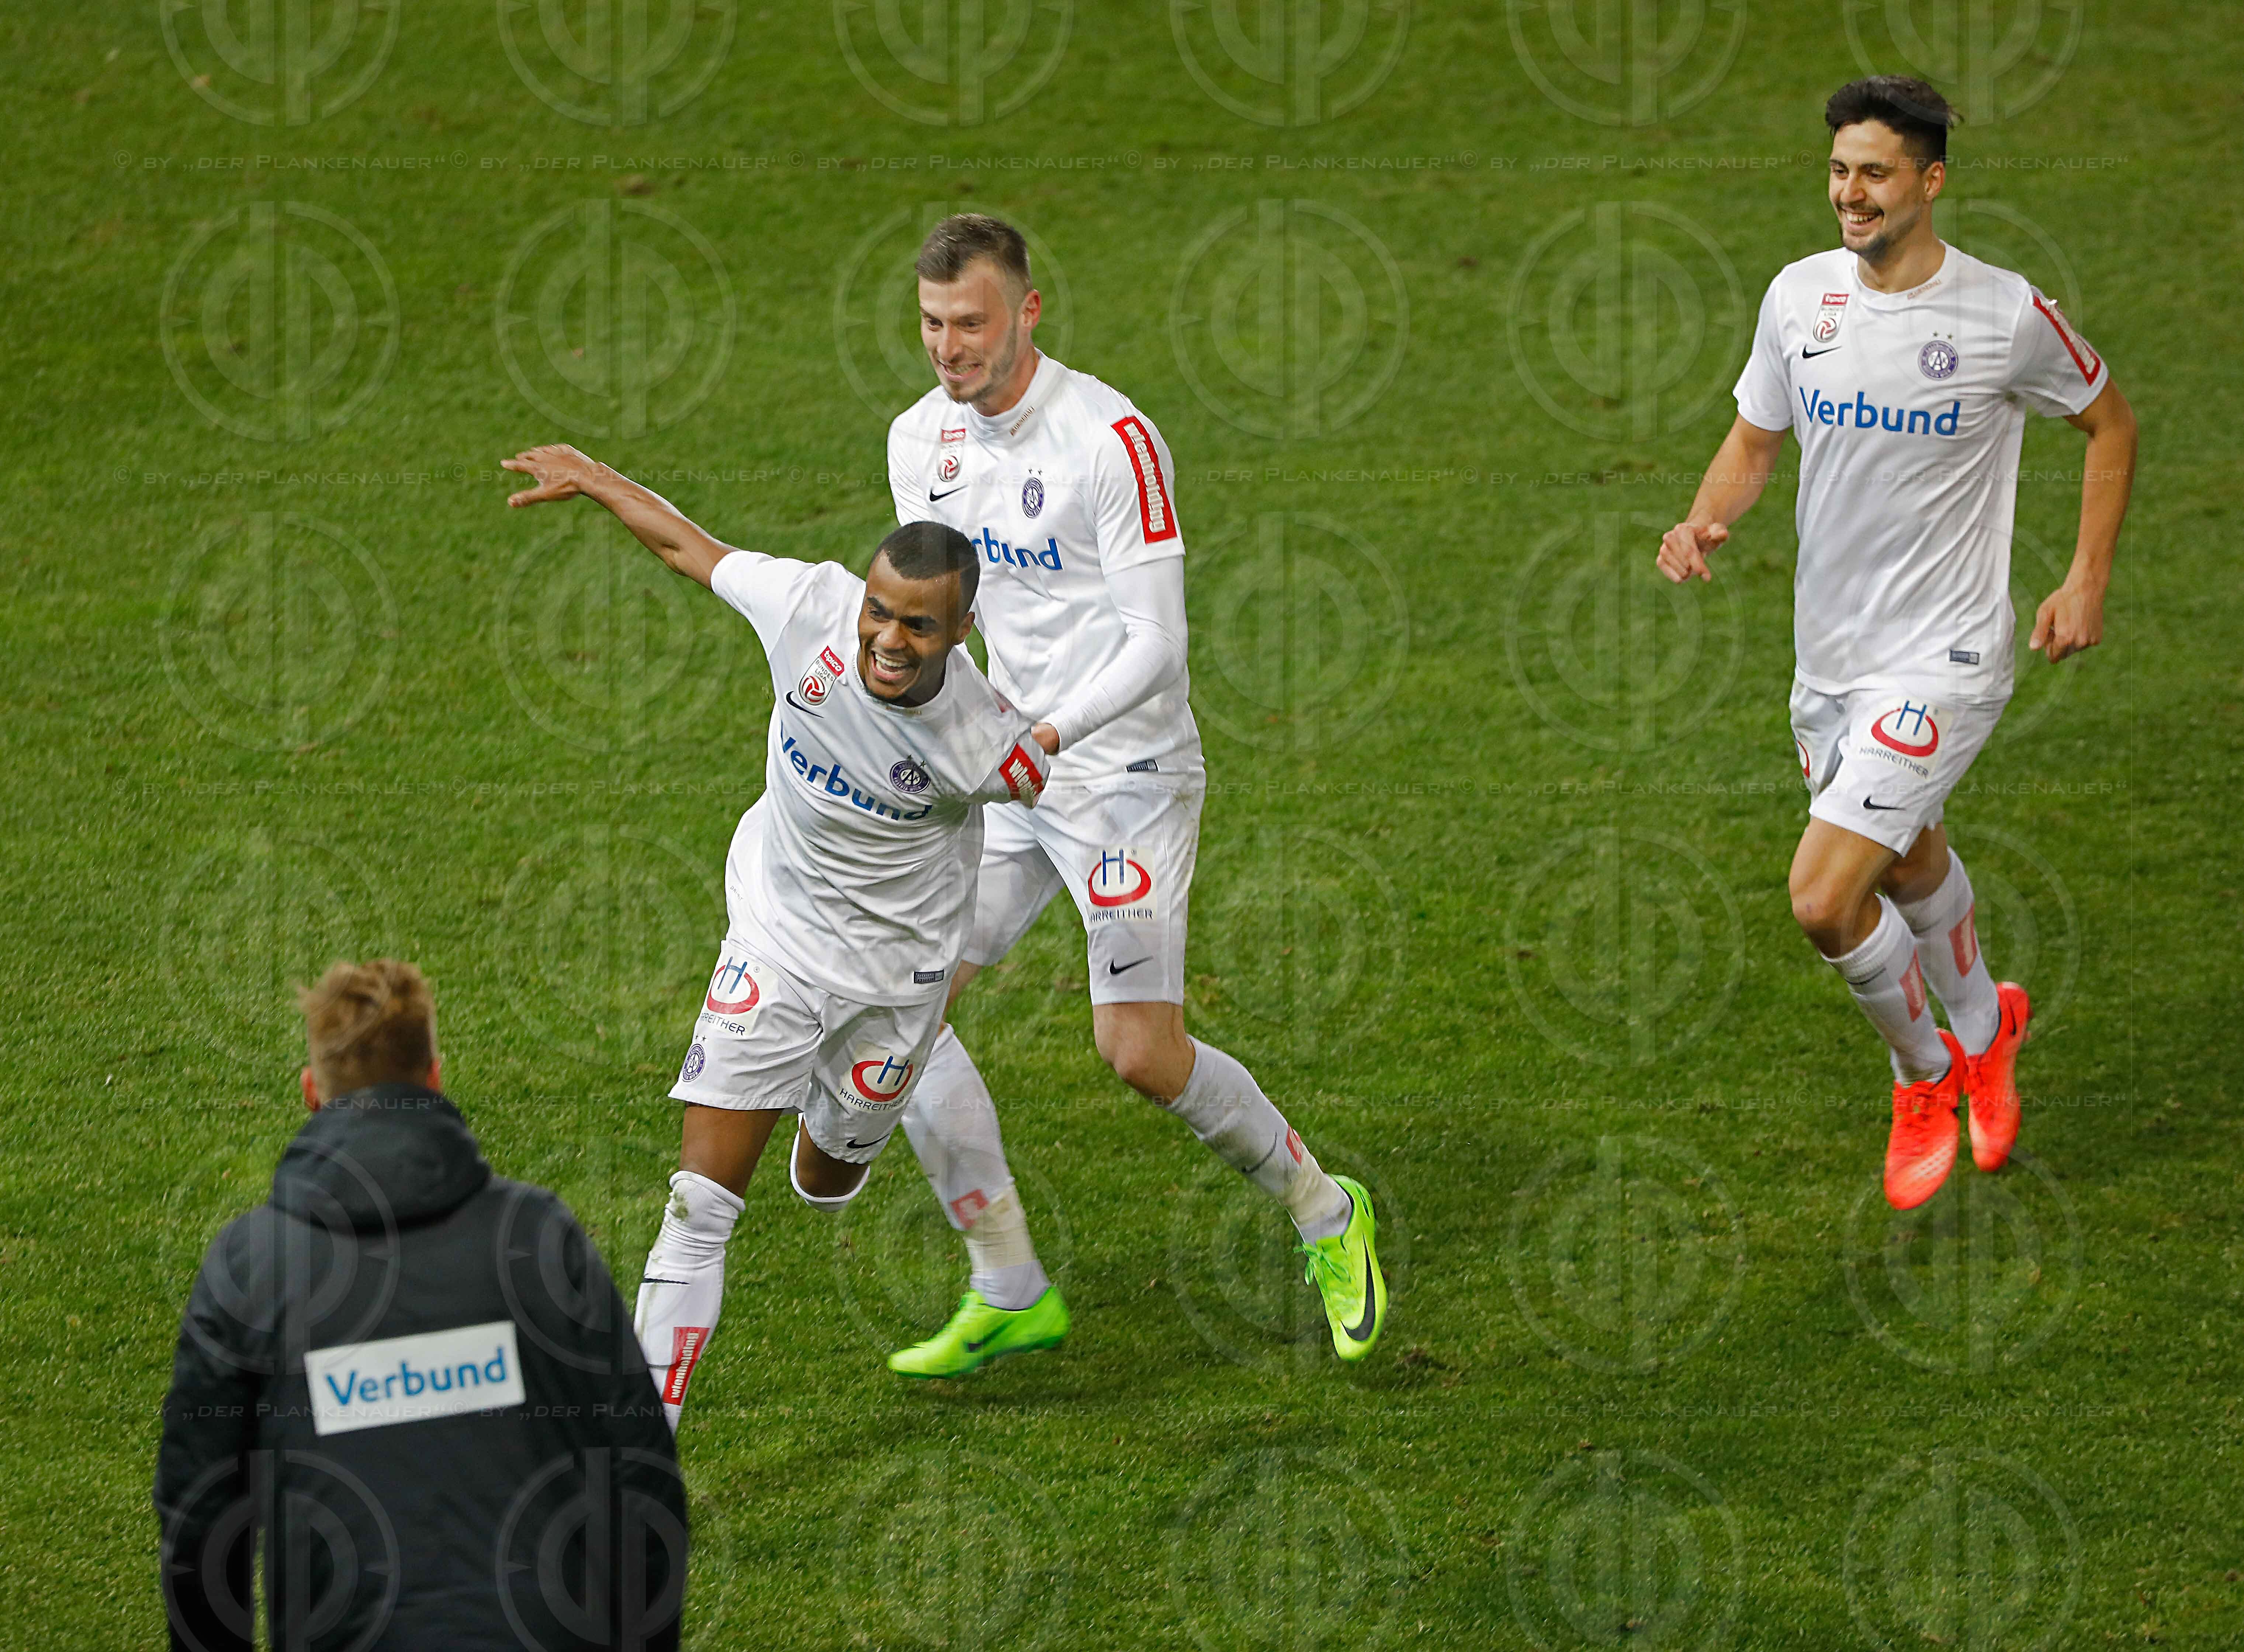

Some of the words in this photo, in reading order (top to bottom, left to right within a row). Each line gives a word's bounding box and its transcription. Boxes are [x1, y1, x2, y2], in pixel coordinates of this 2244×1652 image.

[1799, 386, 1961, 435] Verbund
[972, 528, 1062, 570] rbund
[815, 669, 826, 681] LIGA
[824, 650, 842, 671] tipico
[780, 720, 932, 821] Verbund
[1859, 746, 1929, 778] HARREITHER
[840, 1088, 905, 1111] HARREITHER
[325, 1345, 506, 1405] Verbund
